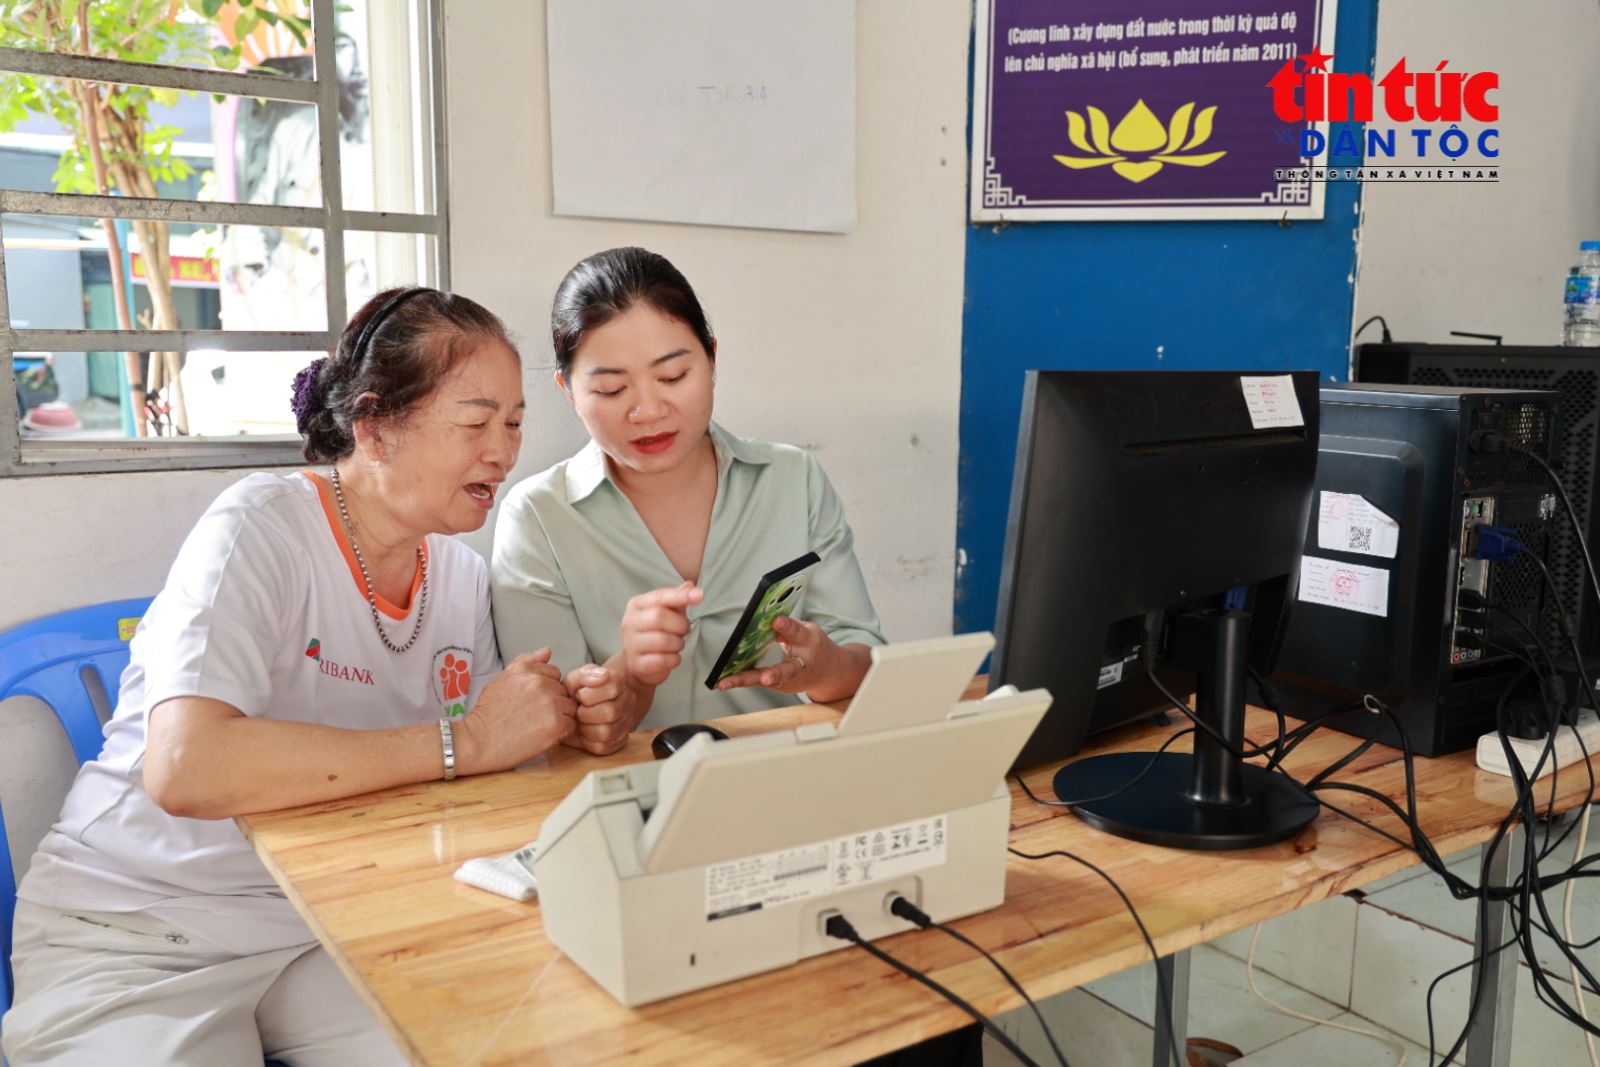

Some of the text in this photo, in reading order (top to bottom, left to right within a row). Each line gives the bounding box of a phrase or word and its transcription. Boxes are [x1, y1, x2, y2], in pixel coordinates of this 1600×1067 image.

[1008, 27, 1046, 46] (Cương
[1049, 24, 1070, 42] lĩnh
[1073, 23, 1093, 42] xây
[1096, 22, 1123, 43] dựng
[1126, 16, 1145, 38] đất
[1147, 18, 1175, 37] nước
[1178, 17, 1209, 35] trong
[1212, 14, 1235, 33] thời
[1255, 12, 1277, 33] quá
[1281, 11, 1296, 33] độ
[1004, 41, 1297, 73] lên chủ nghĩa xã hội (bổ sung, phát triển năm 2011)
